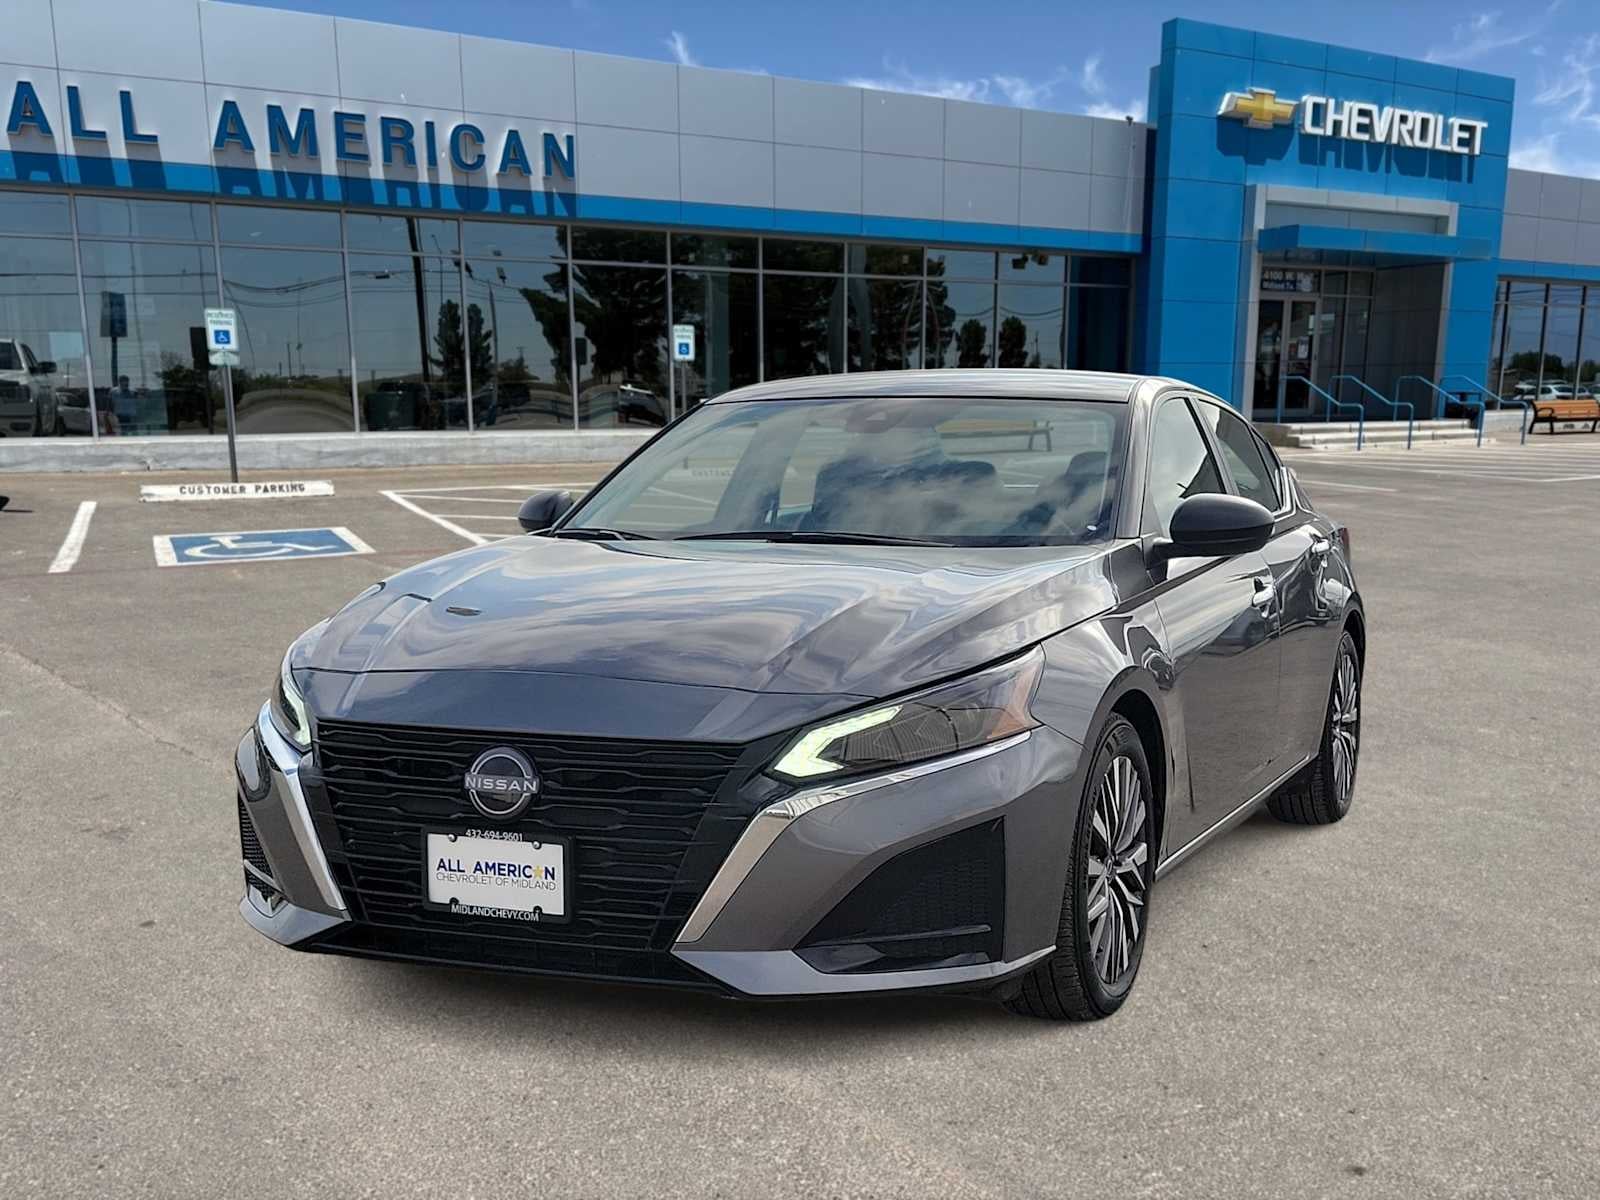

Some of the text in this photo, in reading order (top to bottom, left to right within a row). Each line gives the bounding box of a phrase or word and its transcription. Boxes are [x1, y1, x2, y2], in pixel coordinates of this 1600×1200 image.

[6, 81, 576, 179] ALL AMERICAN
[1301, 94, 1488, 155] CHEVROLET
[179, 483, 305, 496] CUSTOMER PARKING
[465, 777, 537, 792] NISSAN
[465, 829, 523, 842] 432-694-9601
[436, 858, 466, 873] ALL
[436, 872, 557, 891] CHEVROLET OF MIDLAND
[451, 904, 540, 921] MIDLANDCHEVY.COM
